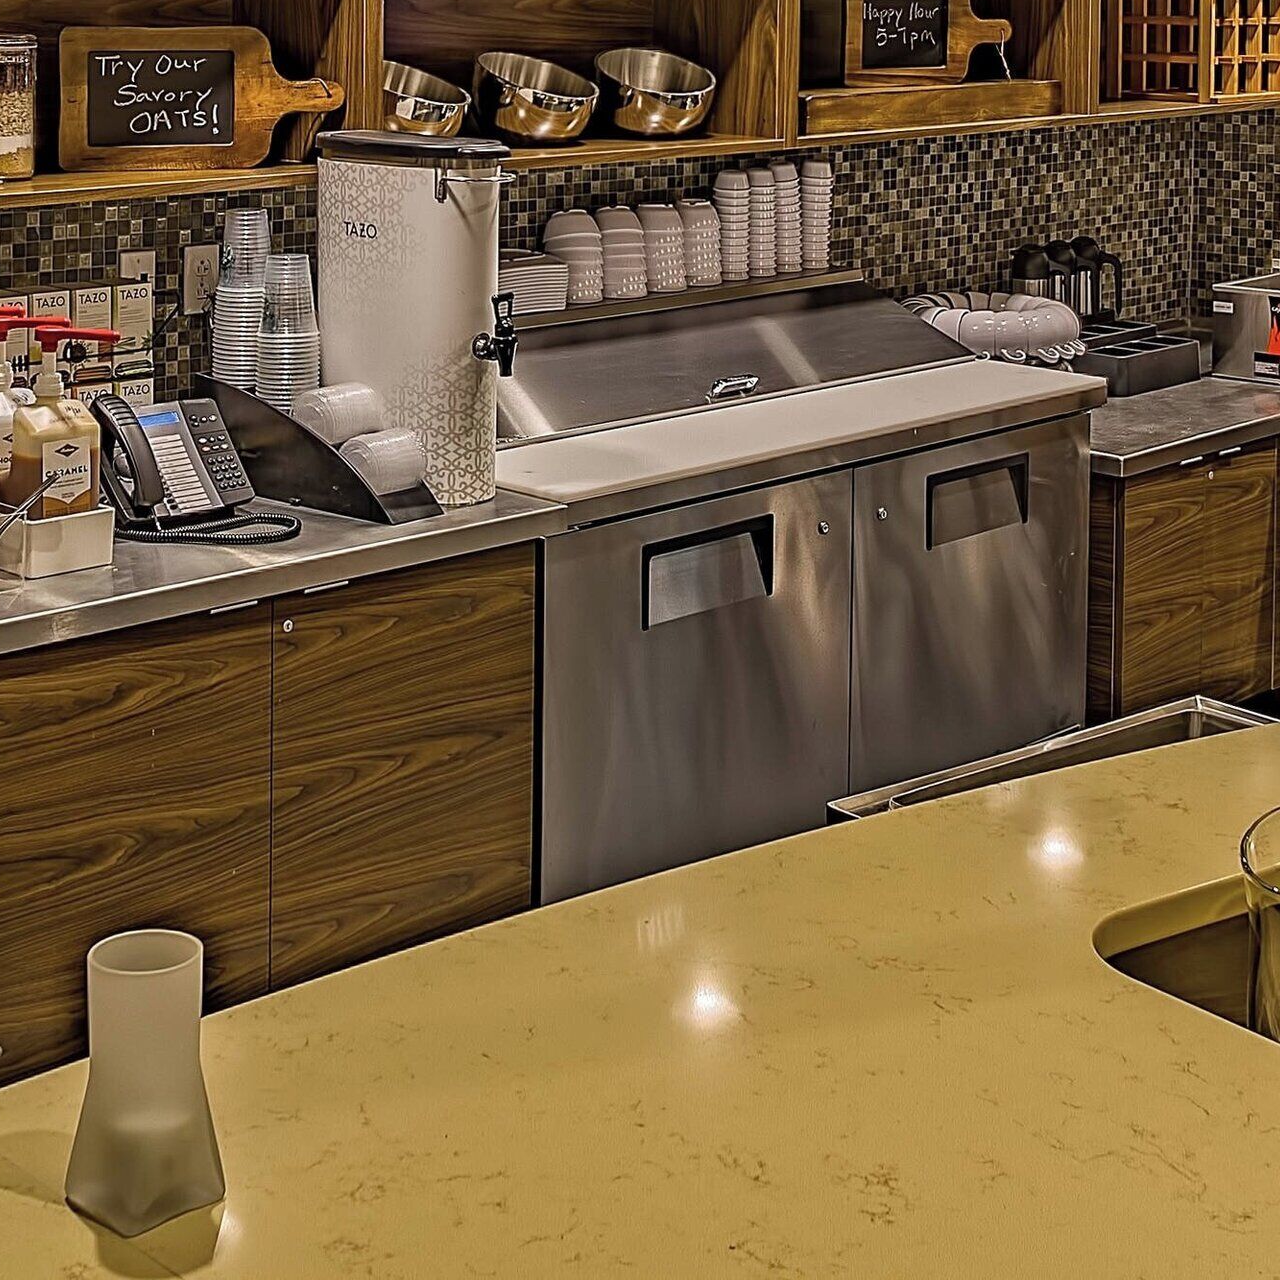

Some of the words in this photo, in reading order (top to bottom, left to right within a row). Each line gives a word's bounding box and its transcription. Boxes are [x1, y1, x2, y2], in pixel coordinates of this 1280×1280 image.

[863, 3, 903, 28] Happy
[909, 2, 939, 21] Hour
[876, 27, 936, 51] 5-7pm
[95, 55, 144, 82] Try
[156, 55, 207, 75] Our
[114, 84, 213, 111] Savory
[130, 104, 220, 135] OATS!
[344, 221, 378, 239] TAZO
[36, 296, 65, 308] TAZO
[79, 292, 108, 304] TAZO
[120, 287, 148, 300] TAZO
[122, 384, 150, 396] TAZO
